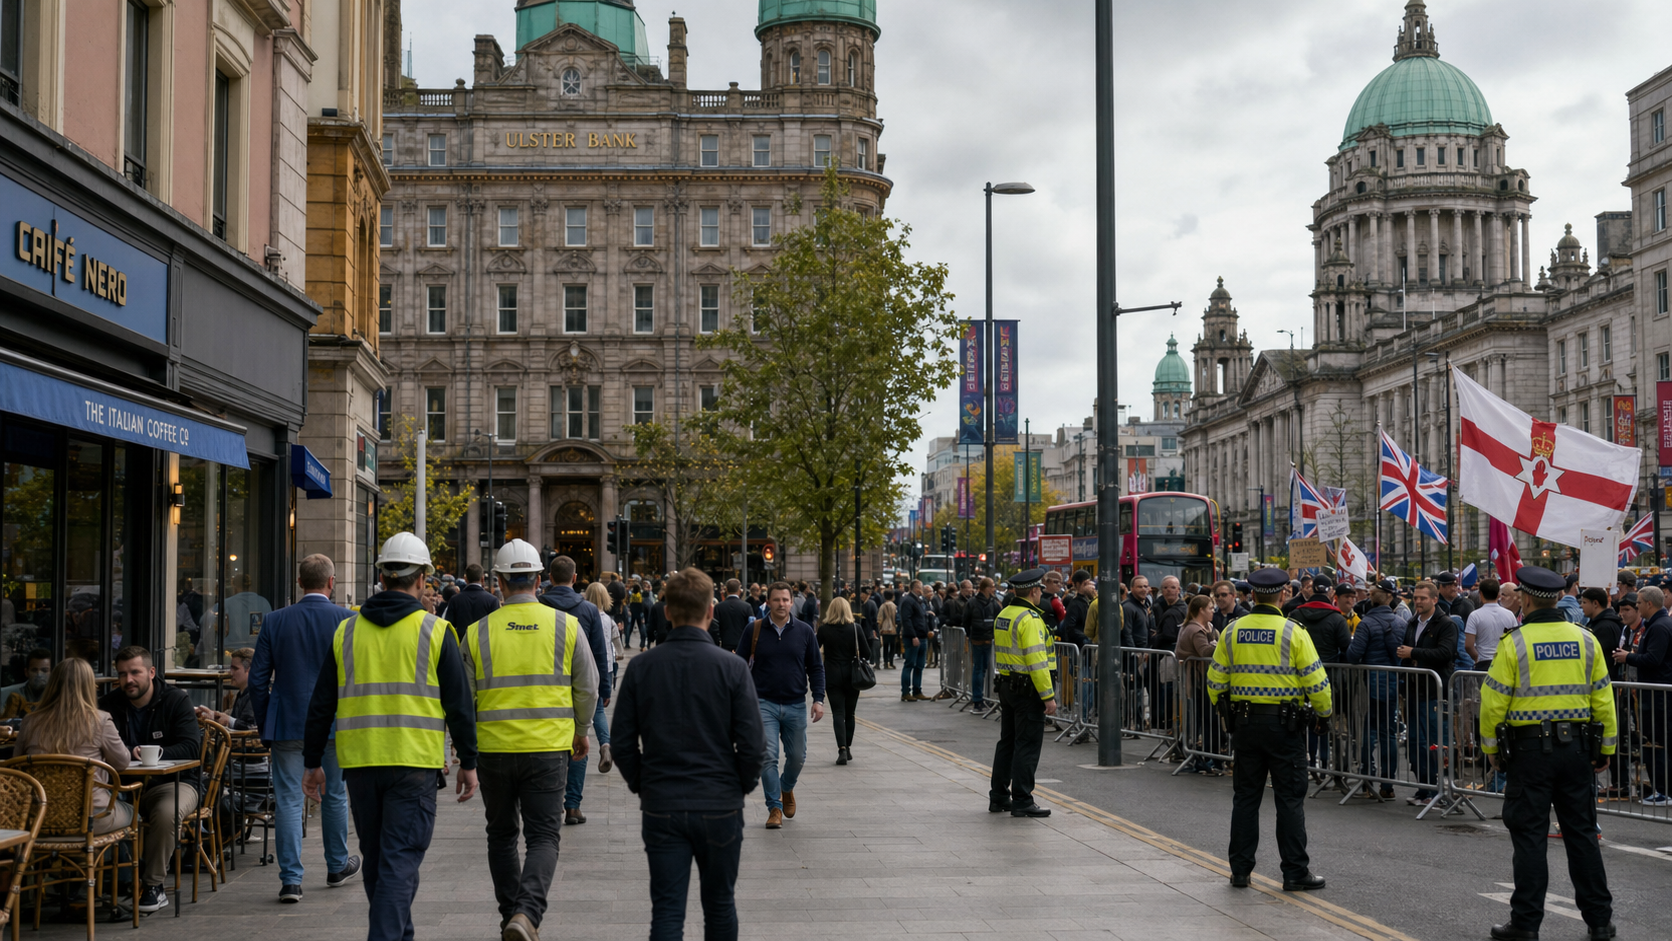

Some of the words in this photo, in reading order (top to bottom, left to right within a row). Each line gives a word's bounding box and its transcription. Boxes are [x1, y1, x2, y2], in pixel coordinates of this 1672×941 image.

[506, 132, 576, 148] ULSTER
[588, 132, 638, 148] BANK
[82, 253, 127, 307] NERO
[85, 400, 104, 425] THE
[108, 406, 144, 435] ITALIAN
[147, 418, 177, 444] COFFEE
[1238, 630, 1274, 642] POLICE
[1536, 643, 1579, 659] POLICE
